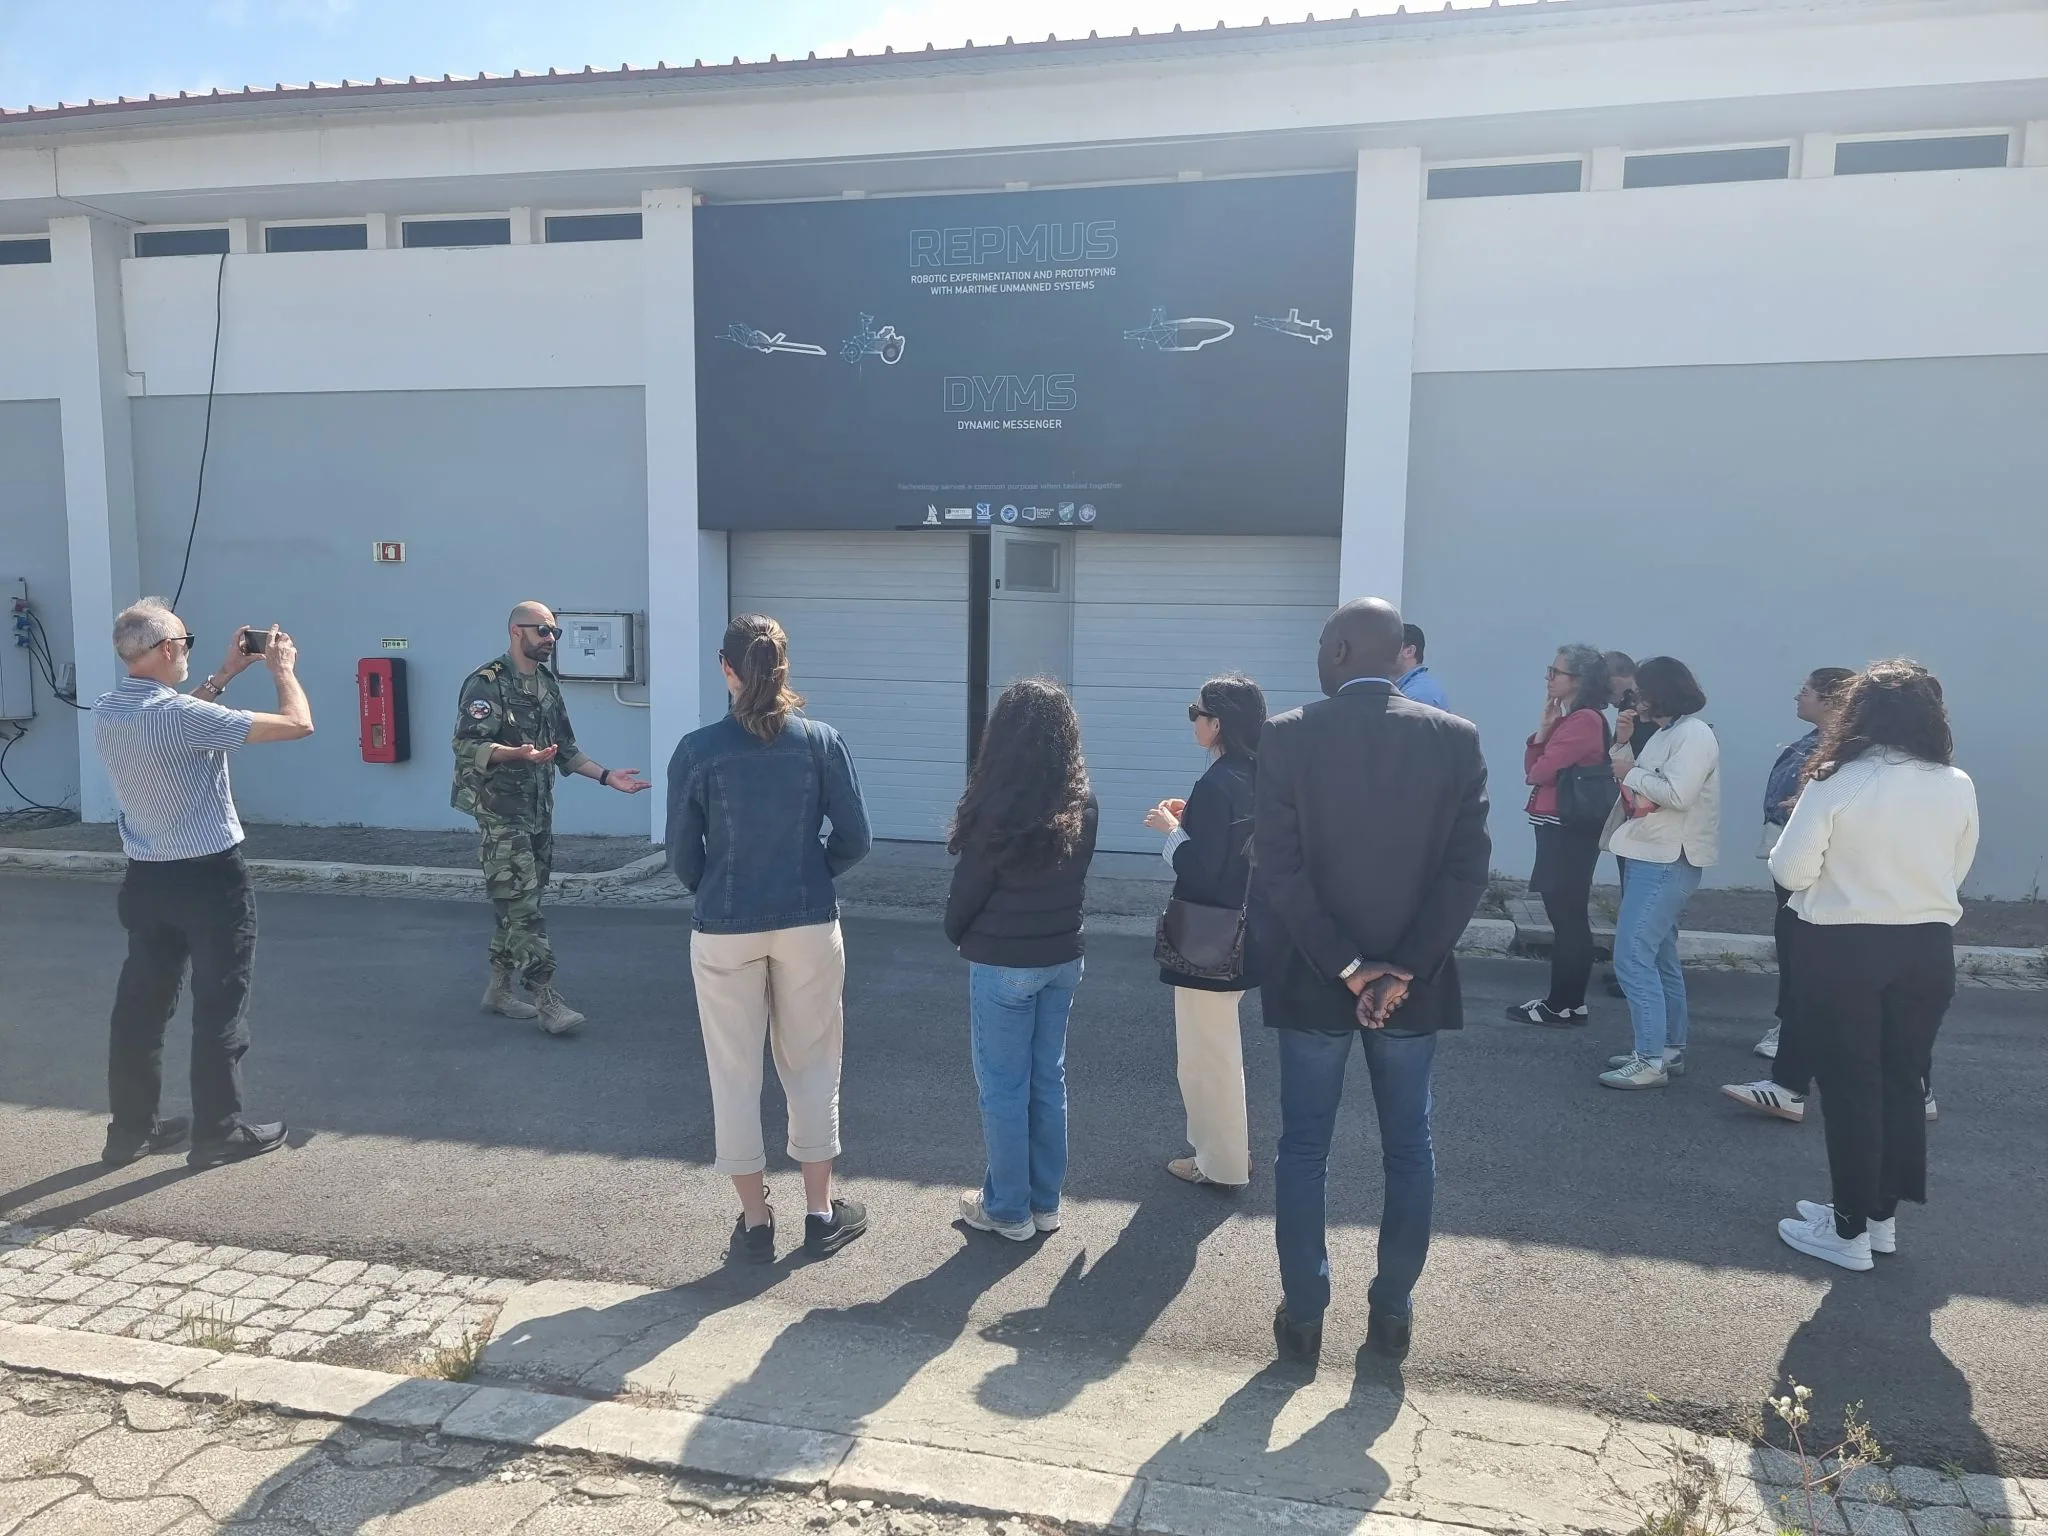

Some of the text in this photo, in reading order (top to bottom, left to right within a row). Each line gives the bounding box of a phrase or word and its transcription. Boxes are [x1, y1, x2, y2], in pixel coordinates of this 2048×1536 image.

[909, 220, 1119, 268] REPMUS
[911, 267, 1117, 284] ROBOTIC EXPERIMENTATION AND PROTOTYPING
[930, 280, 1095, 295] WITH MARITIME UNMANNED SYSTEMS
[943, 374, 1077, 412] DYMS
[957, 419, 1062, 430] DYNAMIC MESSENGER
